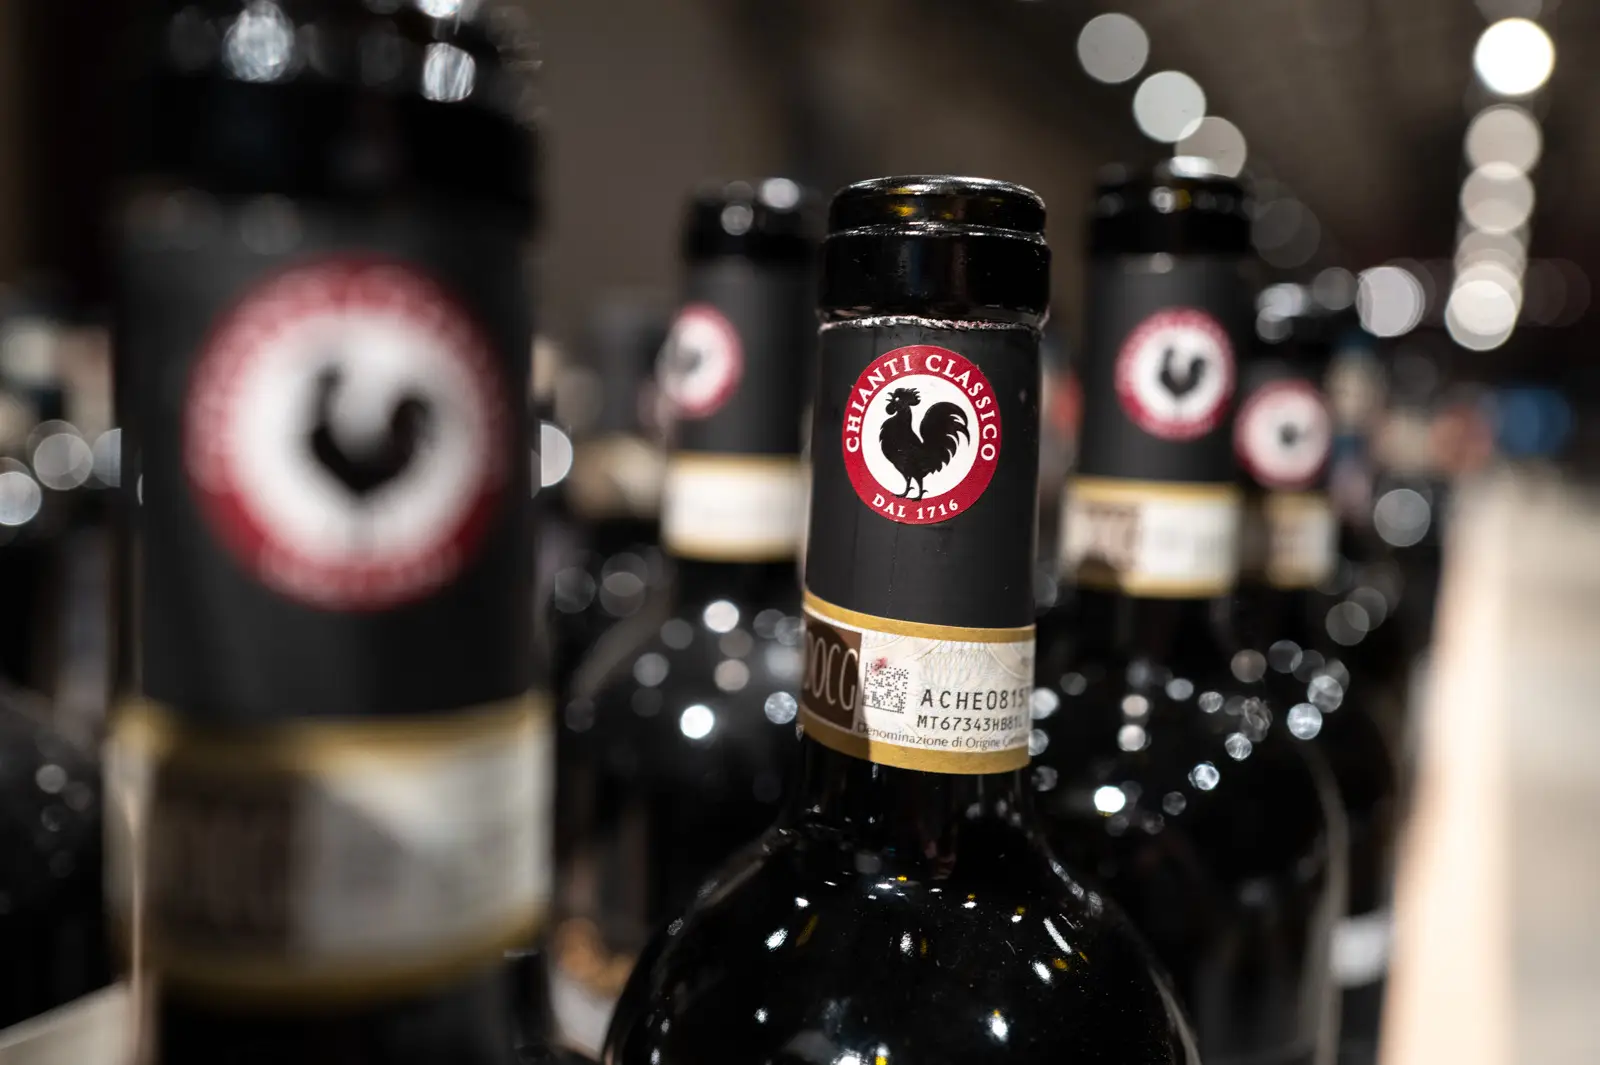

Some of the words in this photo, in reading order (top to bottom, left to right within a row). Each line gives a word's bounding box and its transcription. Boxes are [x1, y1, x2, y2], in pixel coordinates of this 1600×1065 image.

[846, 355, 913, 453] CHIANTI
[925, 354, 998, 461] CLASSICO
[872, 494, 906, 518] DAL
[916, 499, 959, 520] 1716
[857, 722, 949, 747] Denominazione
[951, 737, 963, 748] di
[965, 737, 1000, 751] Origine
